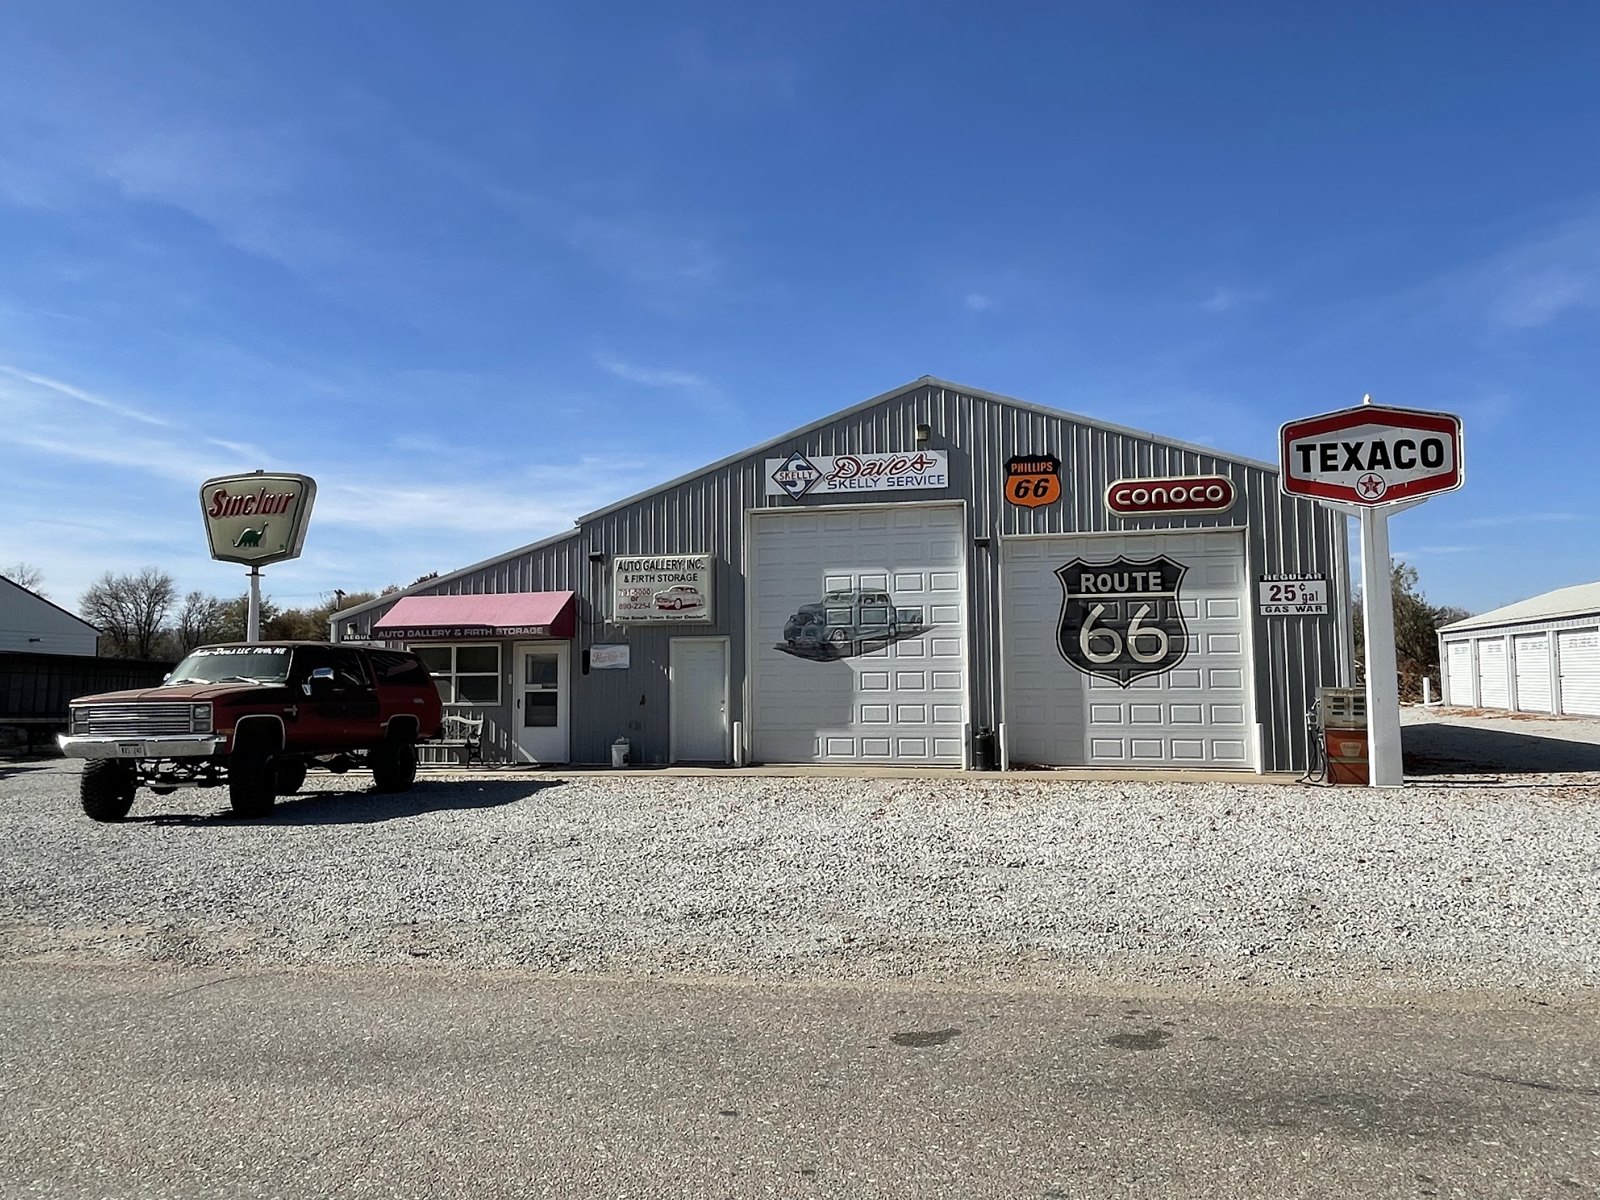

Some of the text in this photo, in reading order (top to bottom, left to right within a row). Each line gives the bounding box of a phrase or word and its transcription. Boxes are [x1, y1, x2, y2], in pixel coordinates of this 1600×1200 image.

[1296, 438, 1444, 473] TEXACO
[1011, 461, 1053, 473] PHILLIPS
[779, 471, 813, 481] SKELLY
[827, 474, 945, 490] SKELLY SERVICE
[1014, 478, 1050, 498] 66
[208, 487, 295, 518] Sinclair
[617, 560, 641, 572] AUTO
[624, 573, 698, 583] & FIRTH STORAGE
[1080, 571, 1162, 593] ROUTE
[1264, 573, 1322, 581] REGULAR
[1301, 591, 1318, 604] gal
[1265, 605, 1323, 613] GAS WAR
[378, 630, 405, 638] AUTO
[407, 629, 452, 637] GALLERY
[464, 628, 493, 636] FIRTH
[496, 627, 544, 635] STORAGE
[1080, 603, 1169, 664] 66
